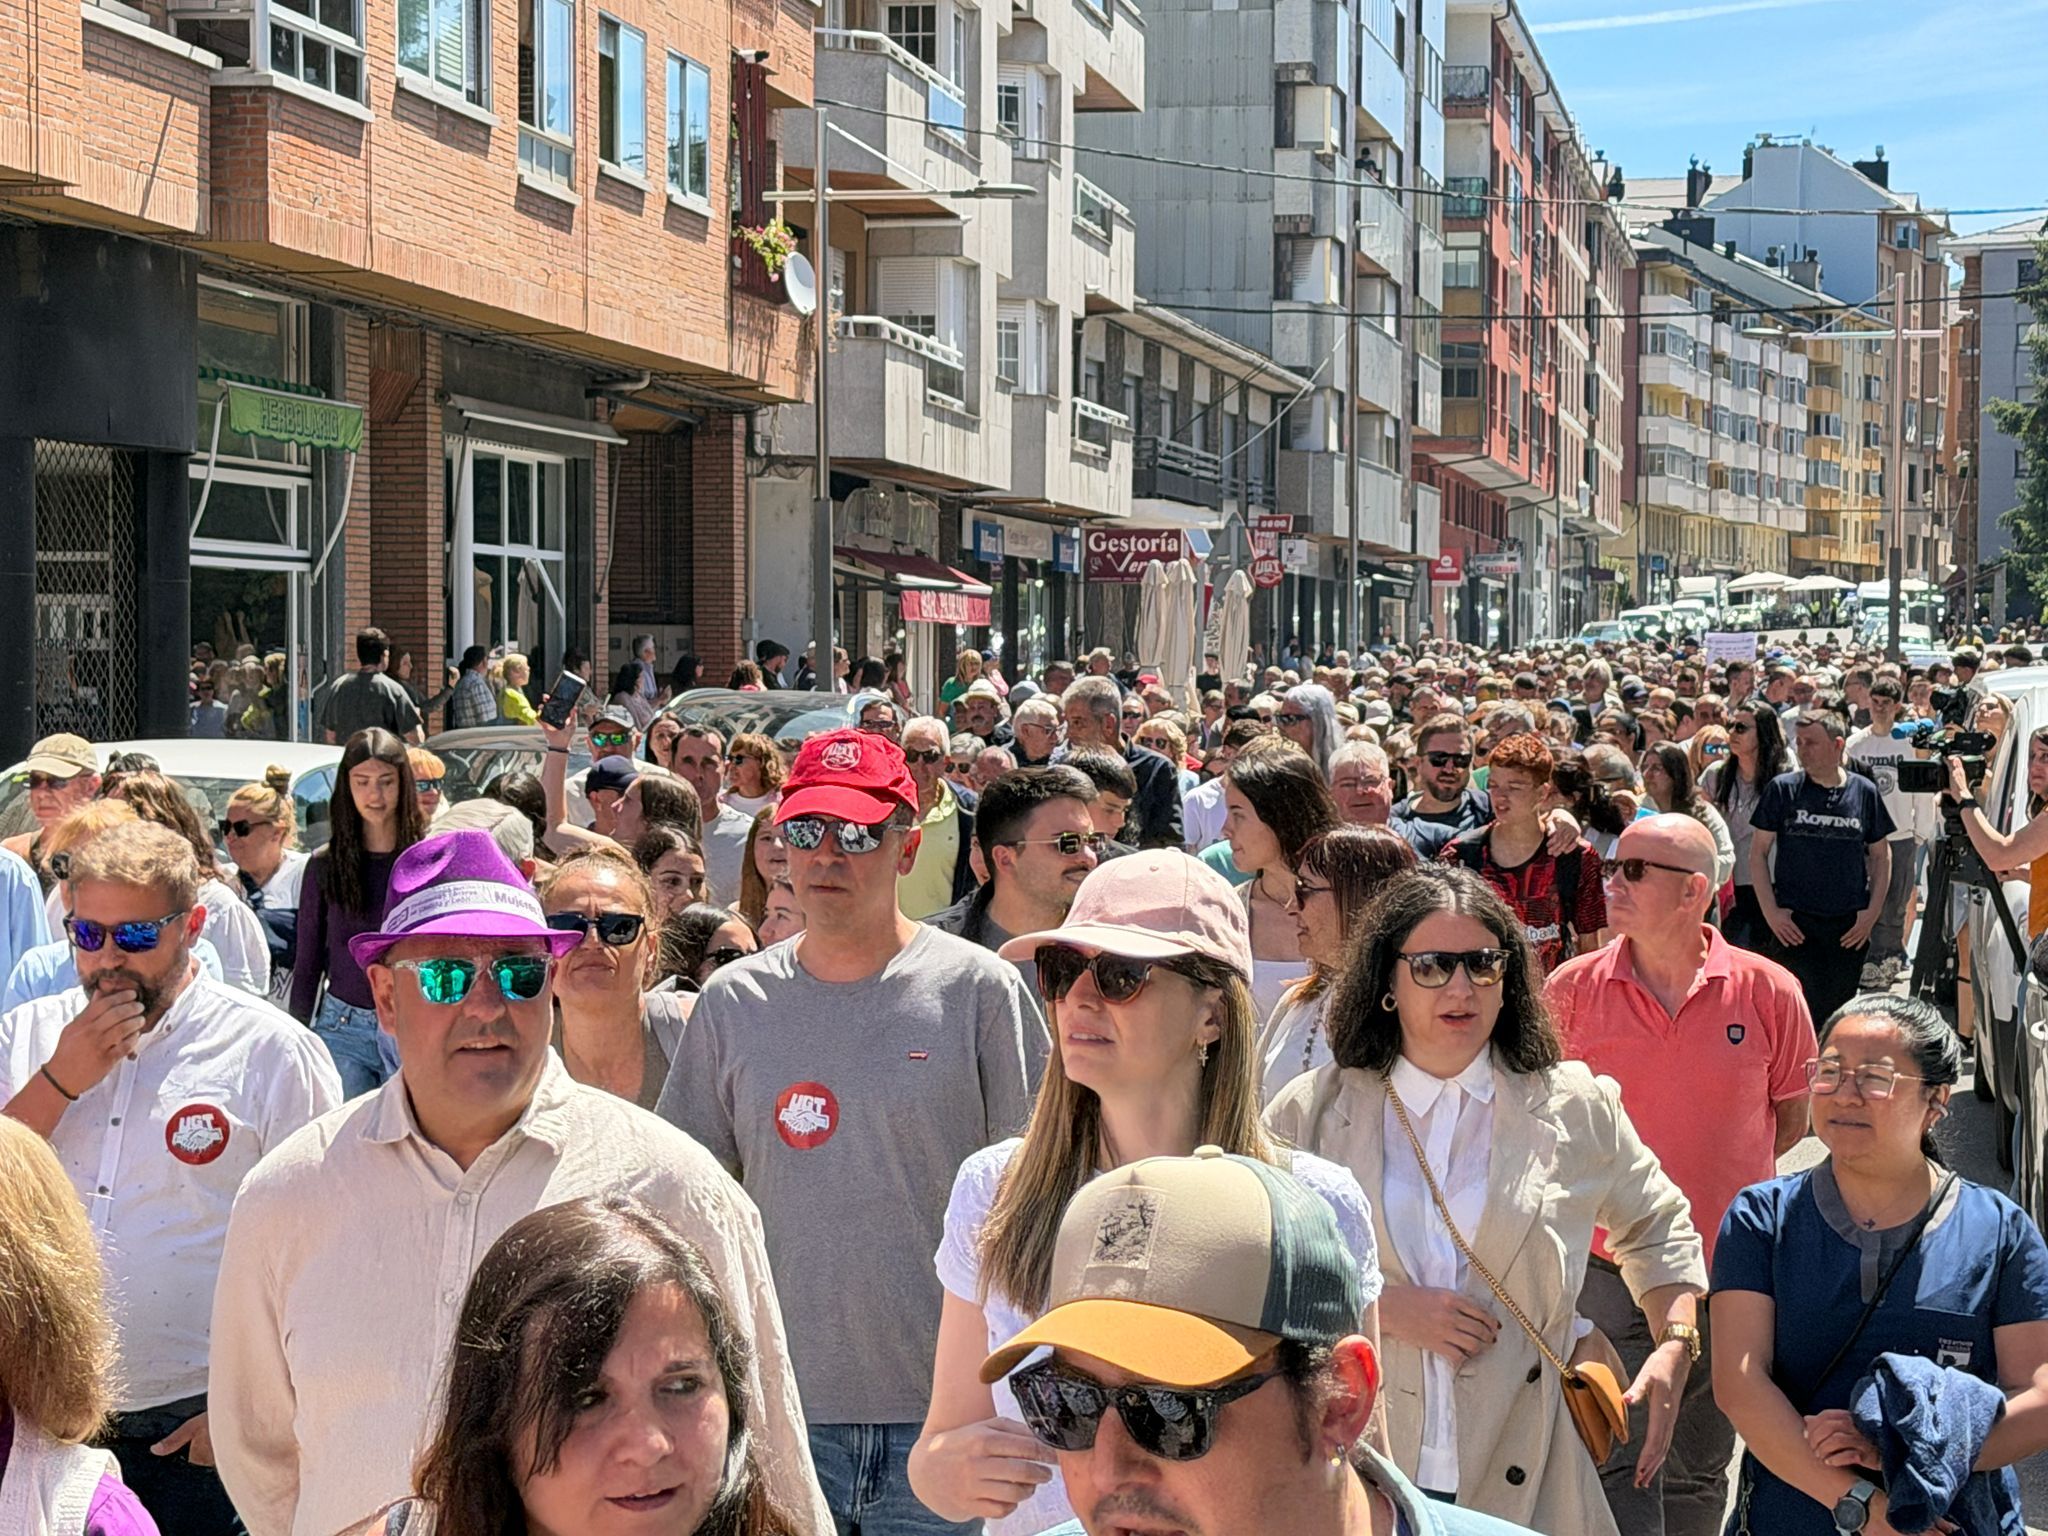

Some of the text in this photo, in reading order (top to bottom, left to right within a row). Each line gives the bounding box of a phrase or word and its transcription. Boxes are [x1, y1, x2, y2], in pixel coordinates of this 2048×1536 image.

[260, 397, 339, 441] HERBOLARIO
[1088, 531, 1178, 552] Gestoría
[1106, 552, 1149, 573] Ver
[1254, 559, 1280, 576] UGT
[788, 1092, 827, 1115] UGT
[178, 1113, 215, 1132] UGT
